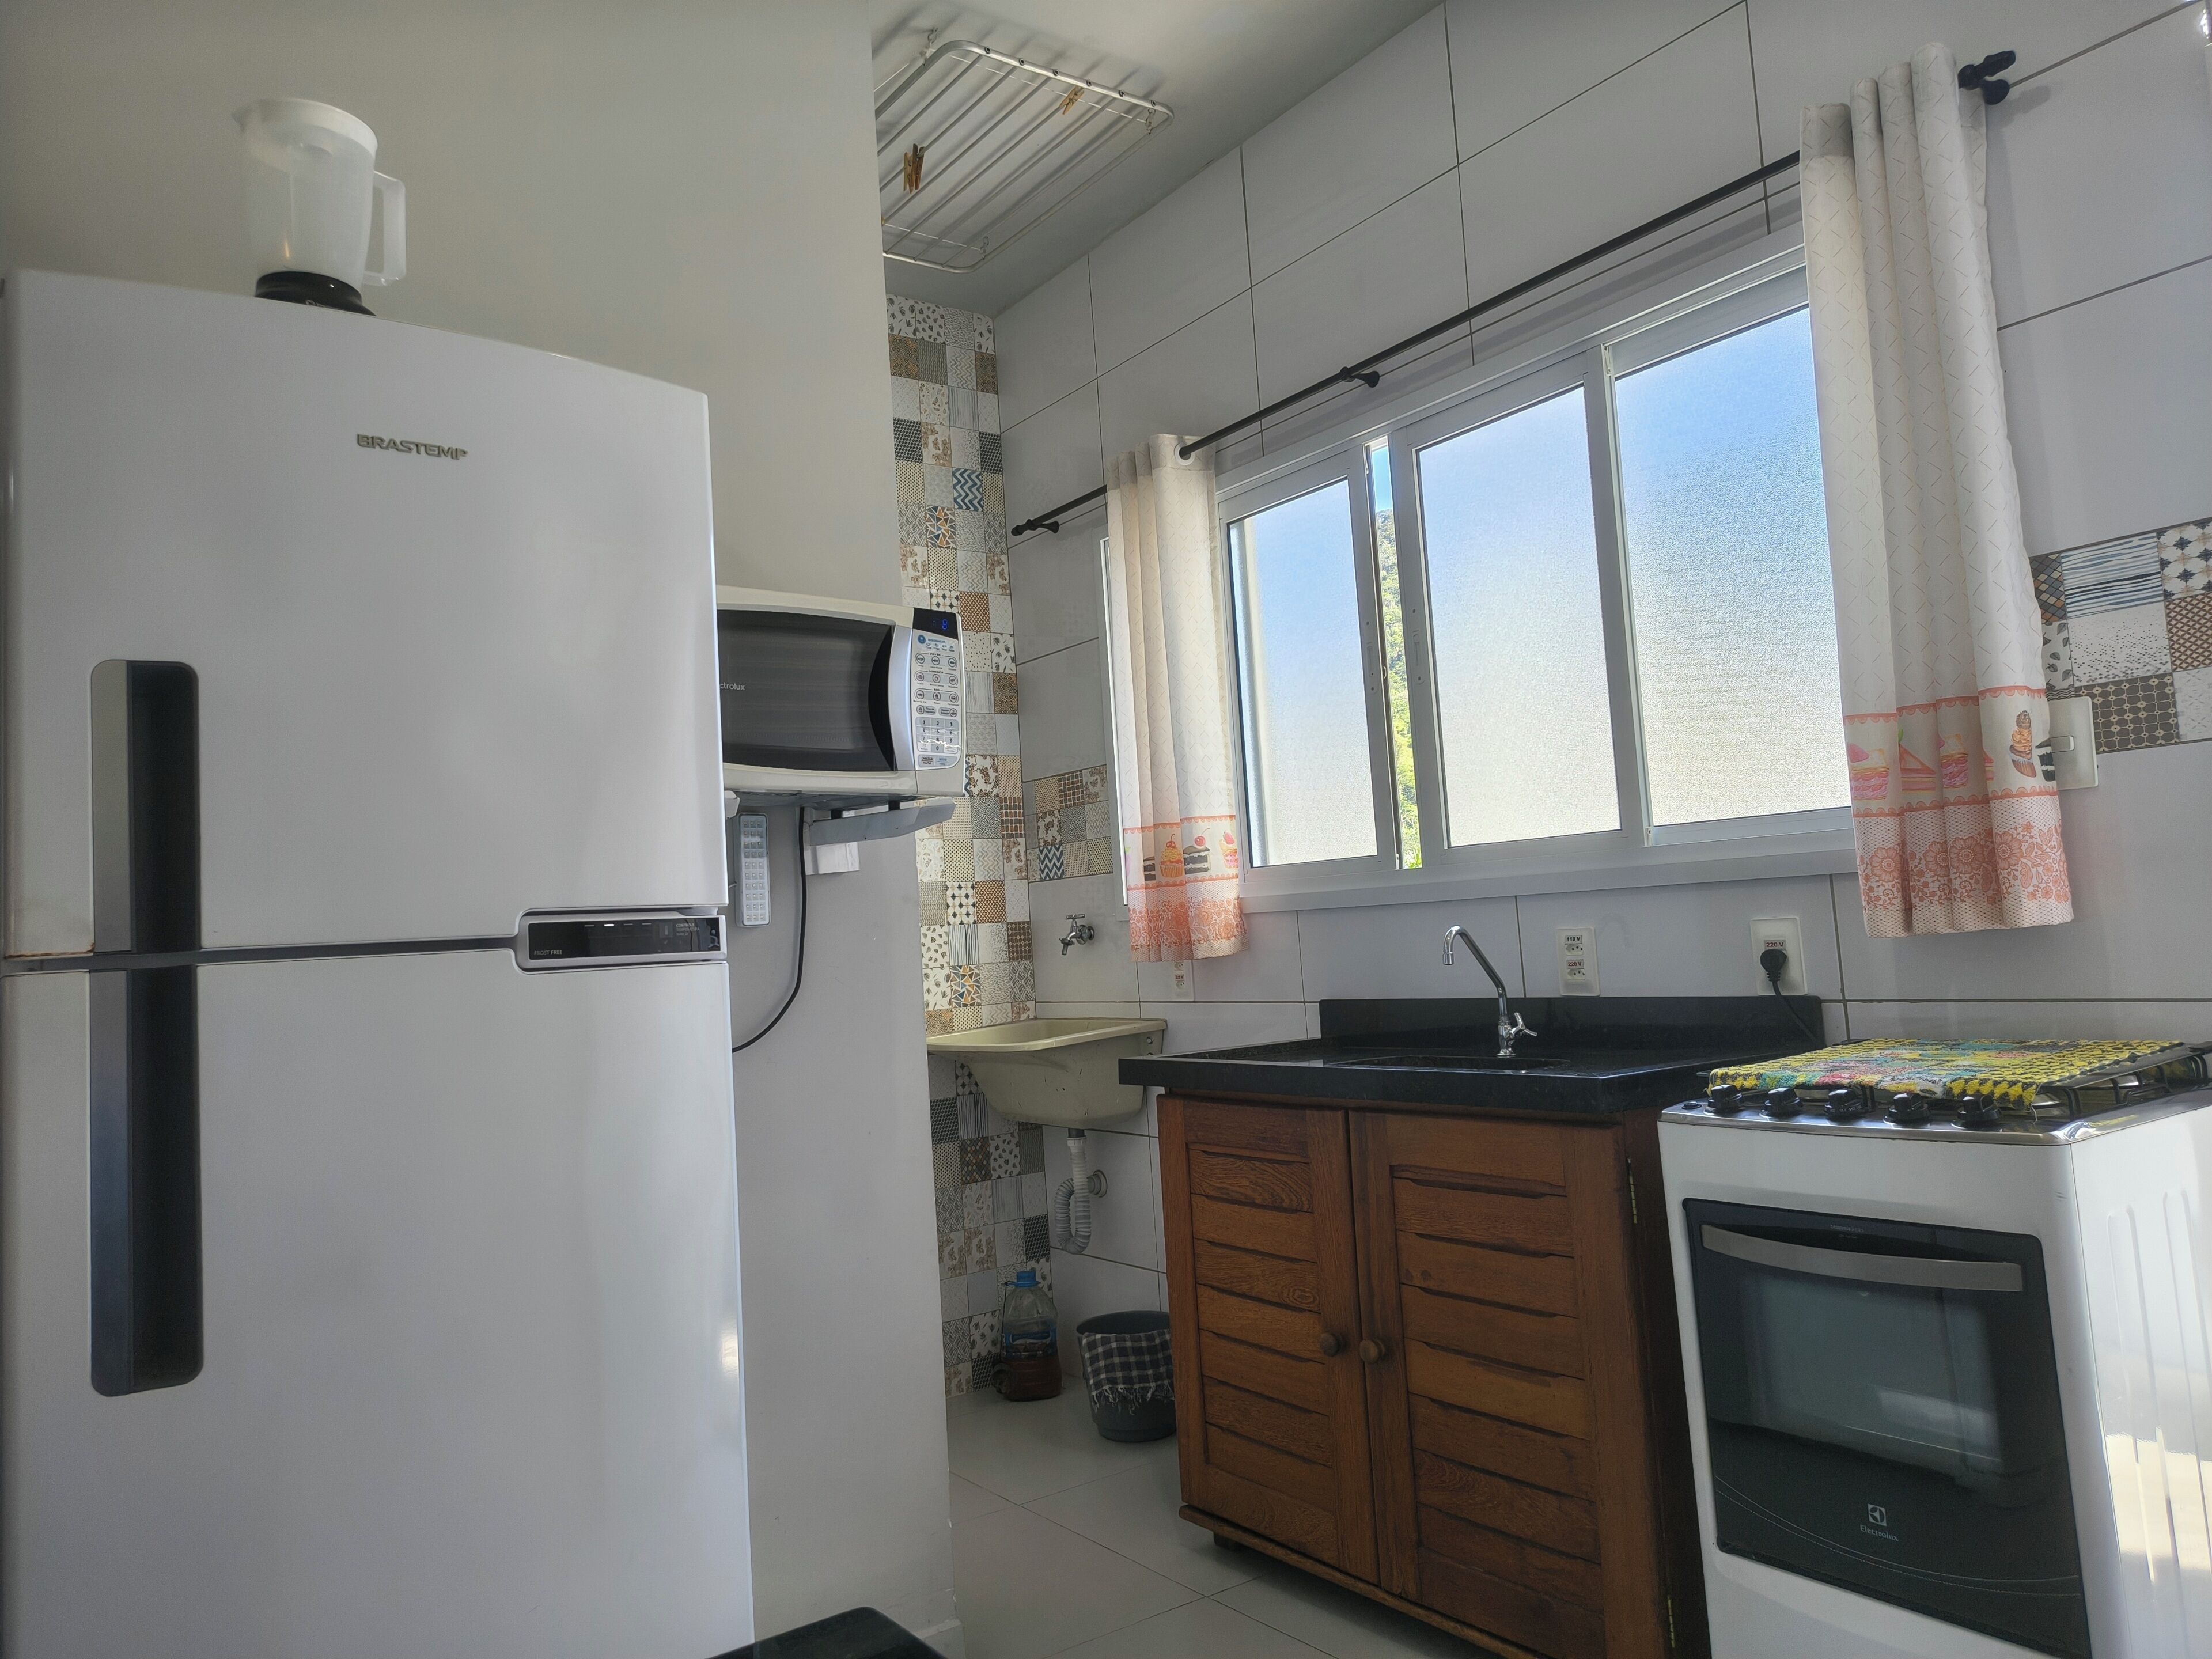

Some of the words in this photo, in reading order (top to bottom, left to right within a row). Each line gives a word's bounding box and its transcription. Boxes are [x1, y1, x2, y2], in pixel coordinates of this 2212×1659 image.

[357, 434, 468, 460] BRASTEMP
[719, 682, 745, 690] ctrolux
[1859, 1524, 1899, 1541] Electrolux
